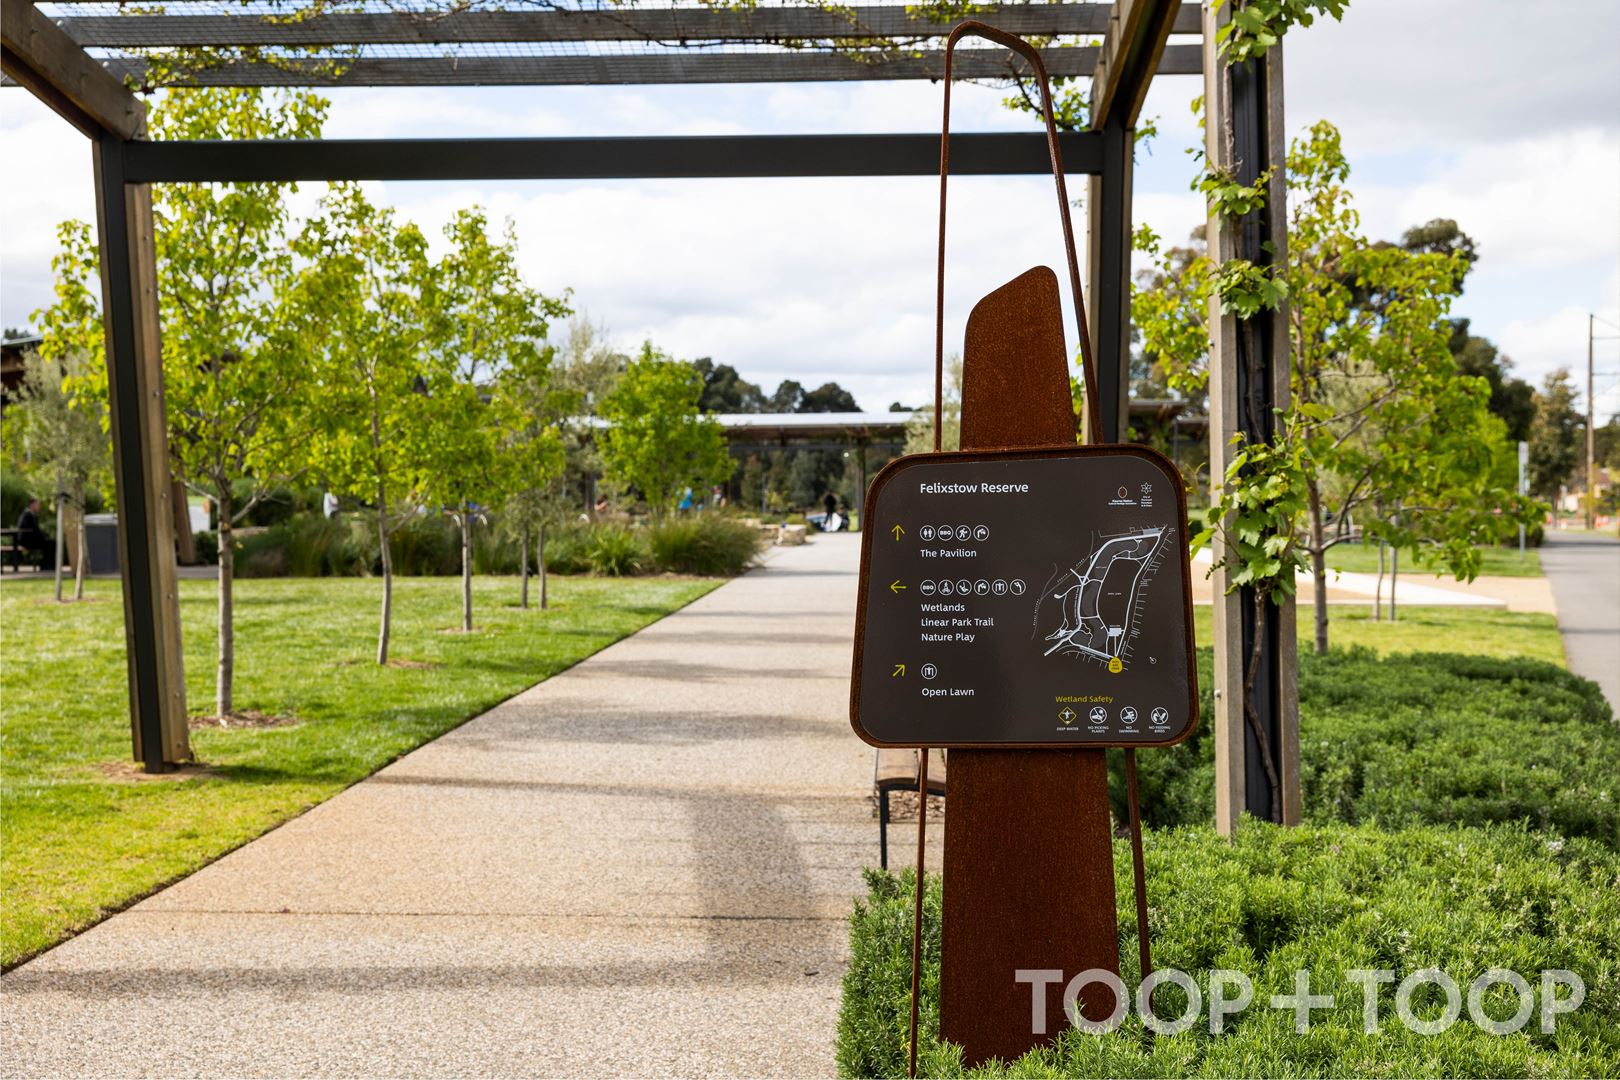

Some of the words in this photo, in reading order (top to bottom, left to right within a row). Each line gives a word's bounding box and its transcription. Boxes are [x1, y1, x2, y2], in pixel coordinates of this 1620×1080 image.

[920, 483, 978, 494] Felixstow
[981, 483, 1029, 493] Reserve
[920, 550, 938, 558] The
[940, 549, 977, 558] Pavilion
[921, 603, 966, 612] Wetlands
[921, 618, 949, 626] Linear
[952, 618, 972, 626] Park
[974, 618, 994, 626] Trail
[921, 633, 953, 642] Nature
[956, 632, 976, 642] Play
[922, 688, 947, 697] Open
[1090, 696, 1114, 704] Safety
